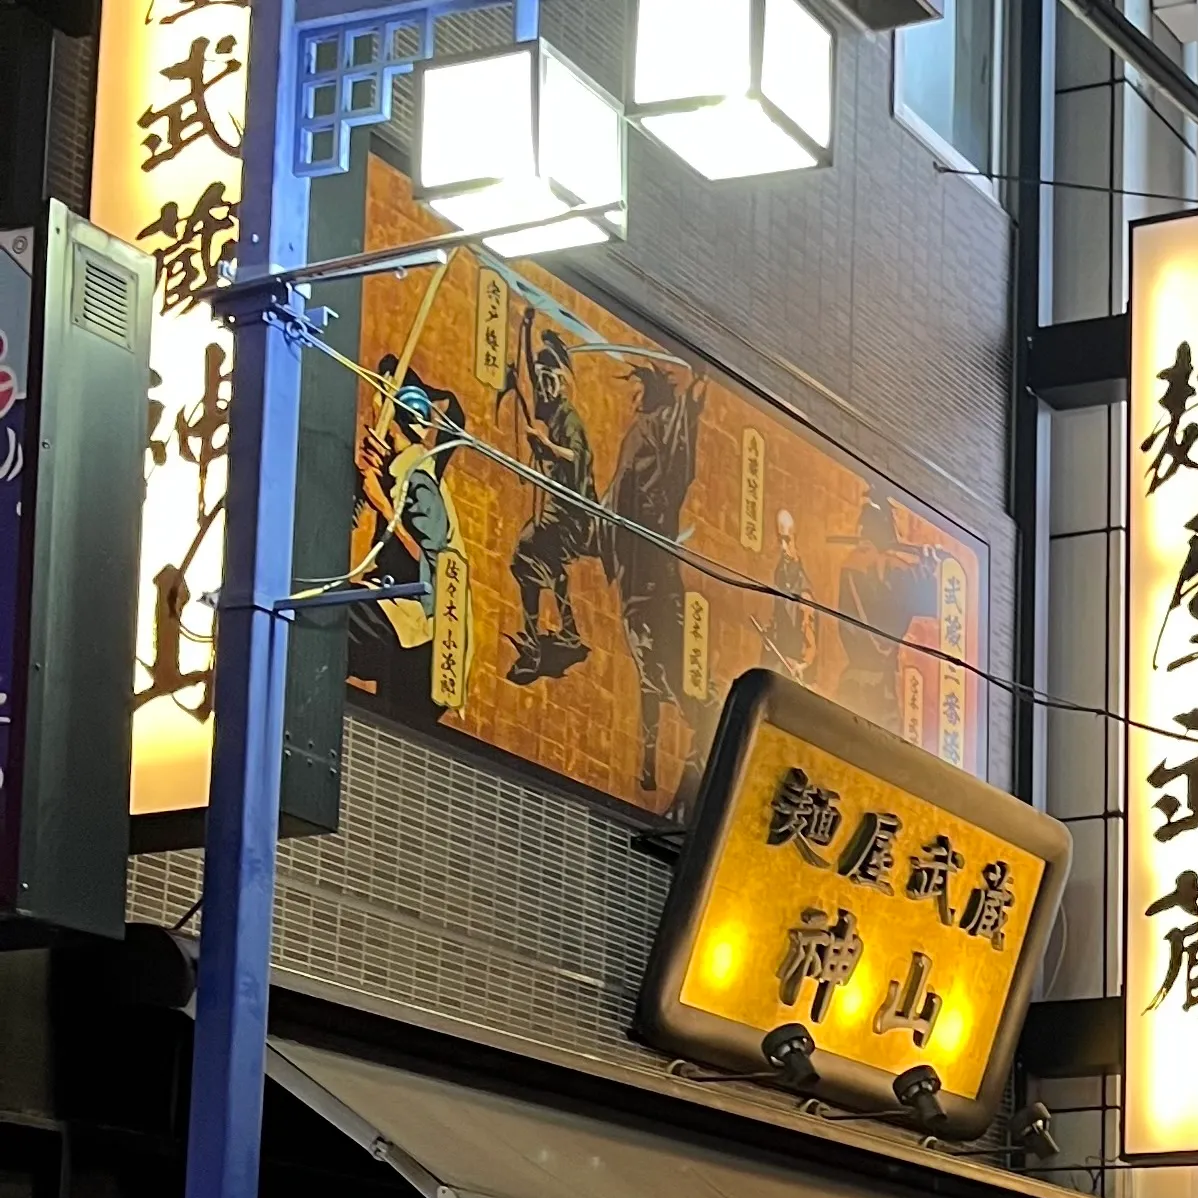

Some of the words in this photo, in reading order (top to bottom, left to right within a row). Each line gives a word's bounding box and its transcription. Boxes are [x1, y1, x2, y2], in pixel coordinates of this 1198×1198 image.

[131, 0, 243, 724] 武蔵神山
[766, 767, 1015, 951] 麺屋武蔵
[775, 907, 943, 1049] 神山
